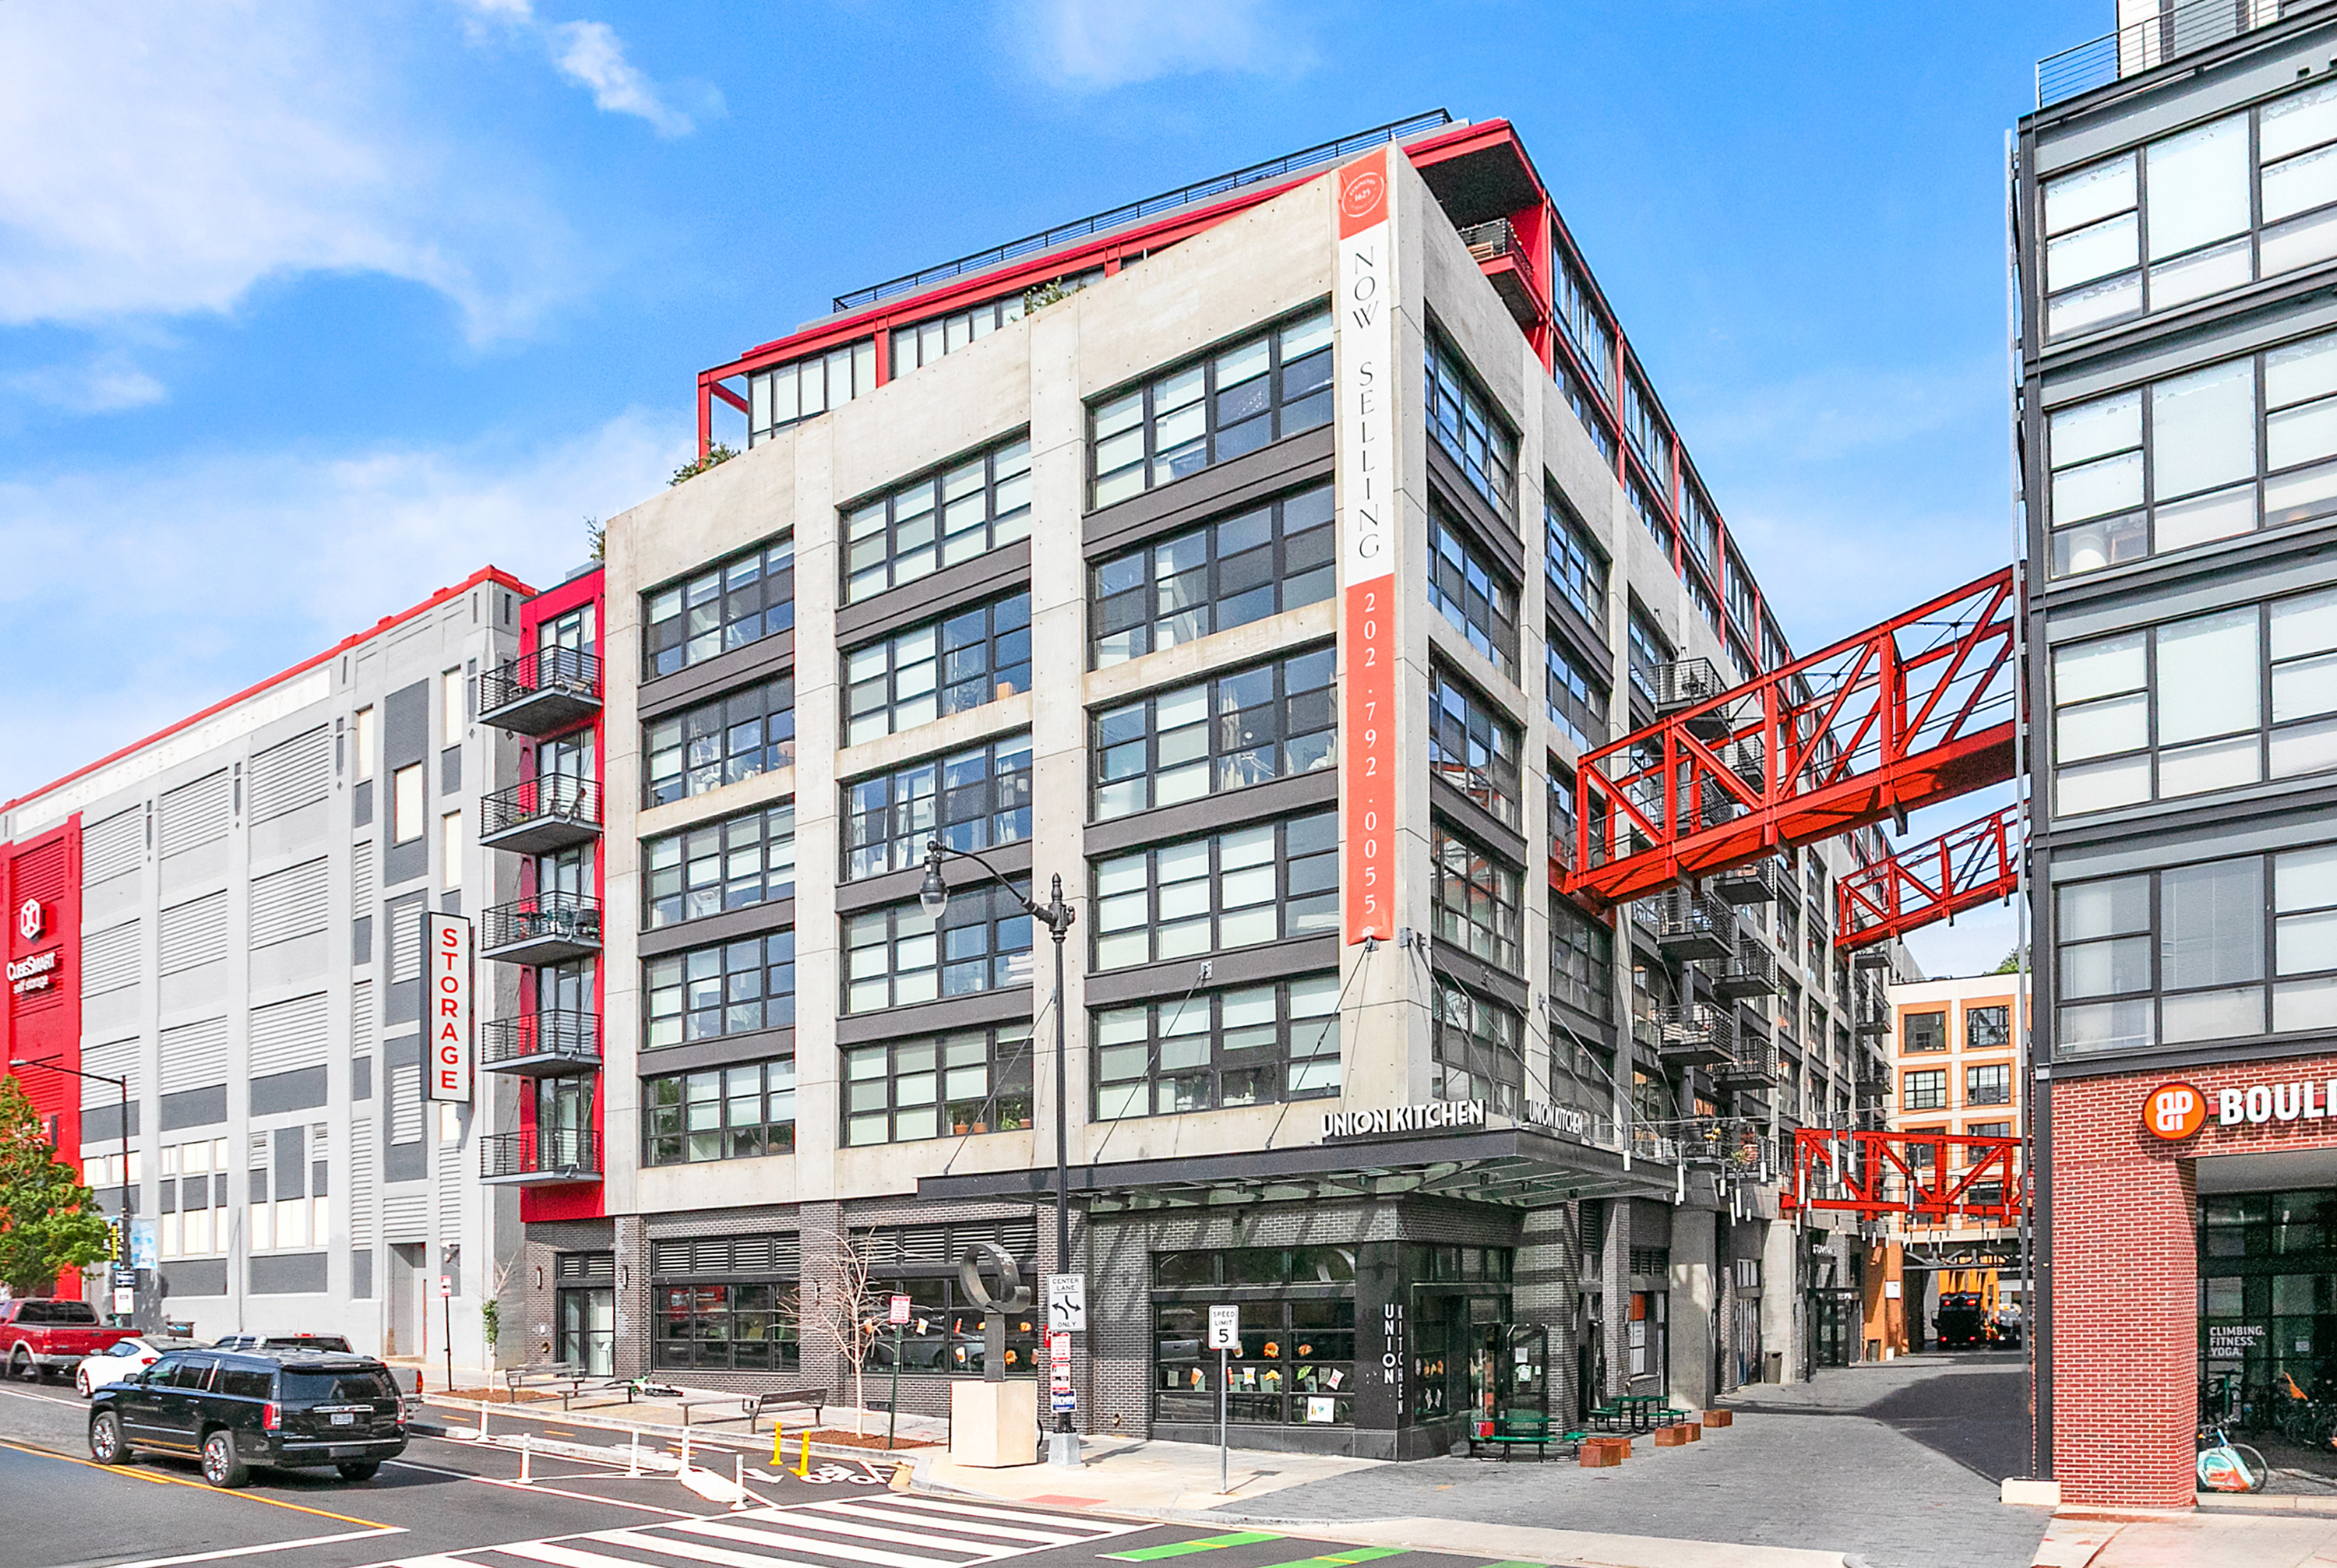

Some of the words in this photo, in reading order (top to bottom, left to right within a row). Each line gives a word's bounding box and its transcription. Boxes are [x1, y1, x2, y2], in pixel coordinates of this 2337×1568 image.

[1353, 245, 1379, 329] NOW
[1359, 361, 1380, 558] SELLING
[440, 928, 459, 1090] STORAGE
[1320, 1109, 1390, 1137] UNION
[1392, 1098, 1485, 1132] KITCHEN
[1529, 1099, 1554, 1128] UNION
[1554, 1107, 1583, 1136] KITCHEN
[1219, 1329, 1228, 1343] 5
[1382, 1303, 1396, 1384] UNION
[2209, 1326, 2265, 1336] CLIMBING.
[2210, 1336, 2257, 1346] FITNESS.
[2210, 1347, 2243, 1356] YOGA.
